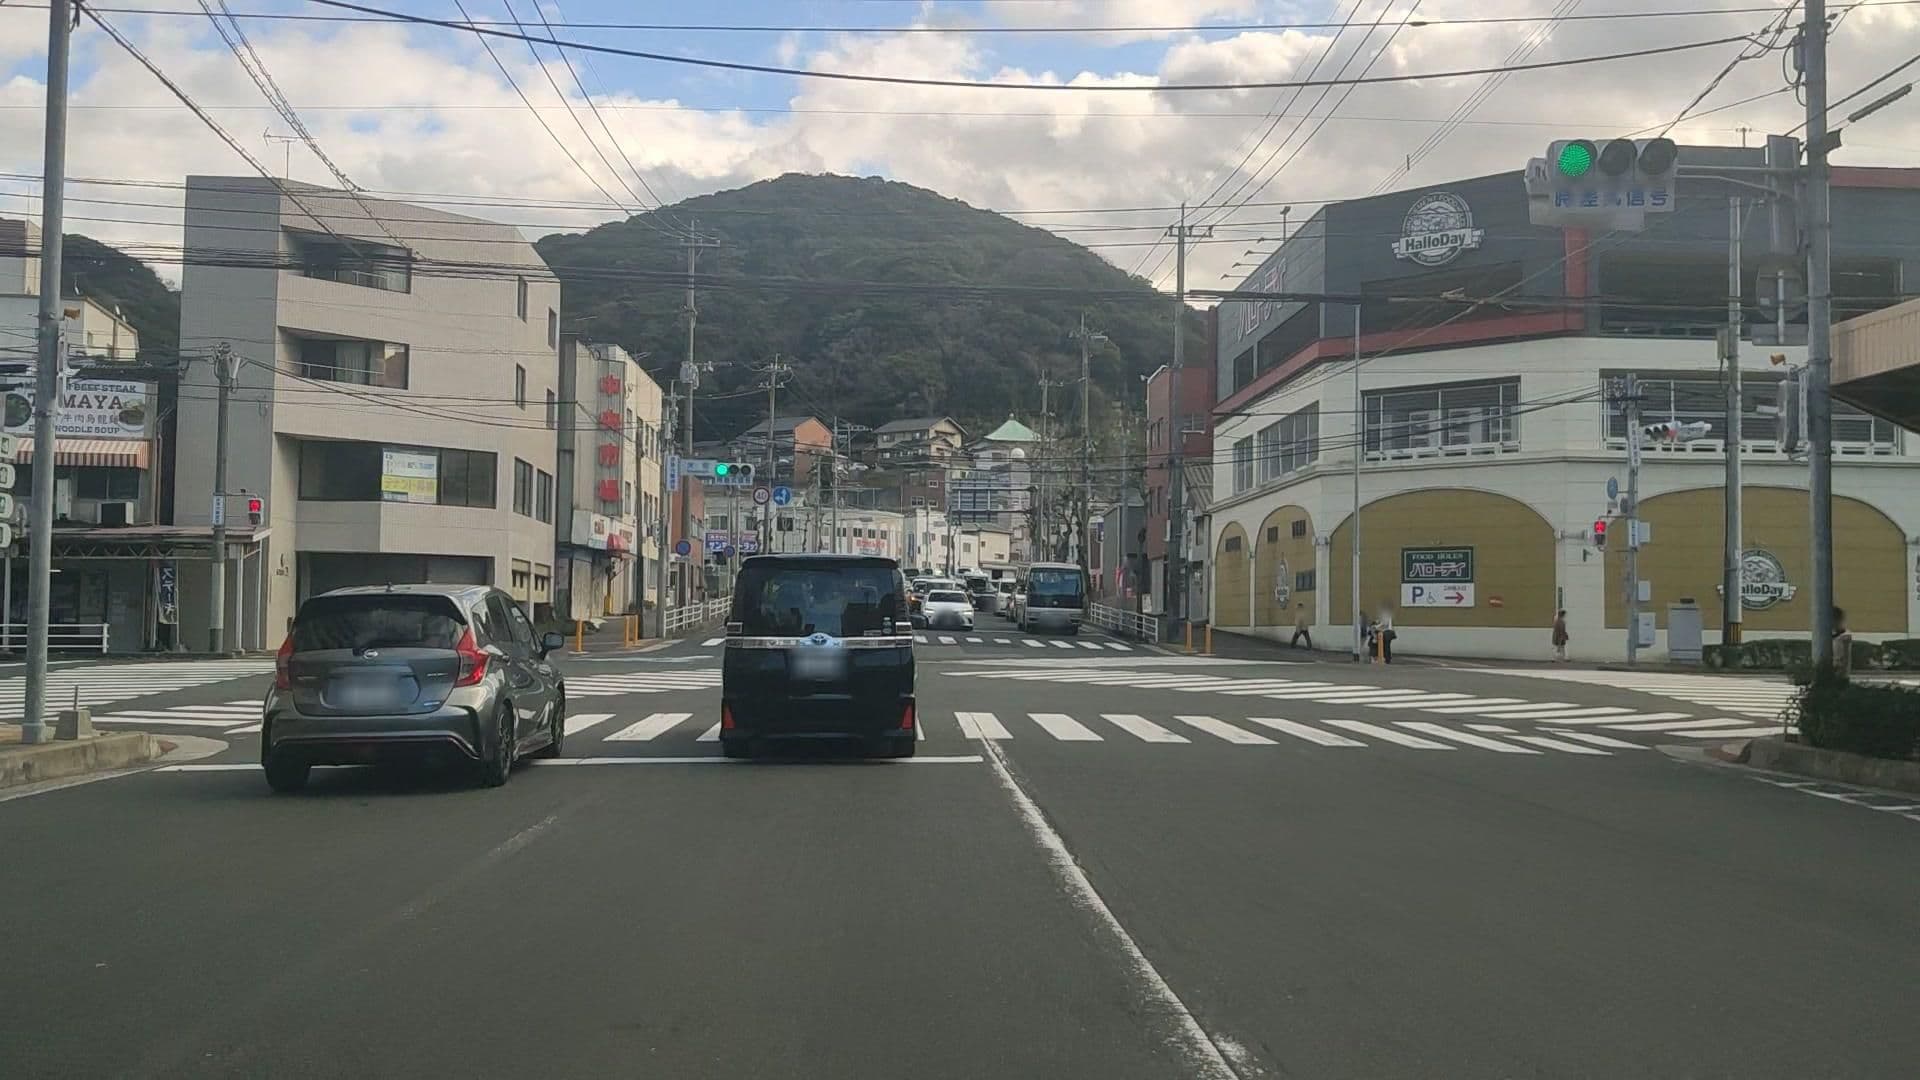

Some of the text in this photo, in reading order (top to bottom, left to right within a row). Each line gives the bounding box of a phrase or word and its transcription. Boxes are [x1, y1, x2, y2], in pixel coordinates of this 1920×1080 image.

[1404, 234, 1466, 252] HalloDay
[756, 491, 768, 499] 40
[162, 567, 176, 615] ステーキ
[1412, 586, 1424, 604] P
